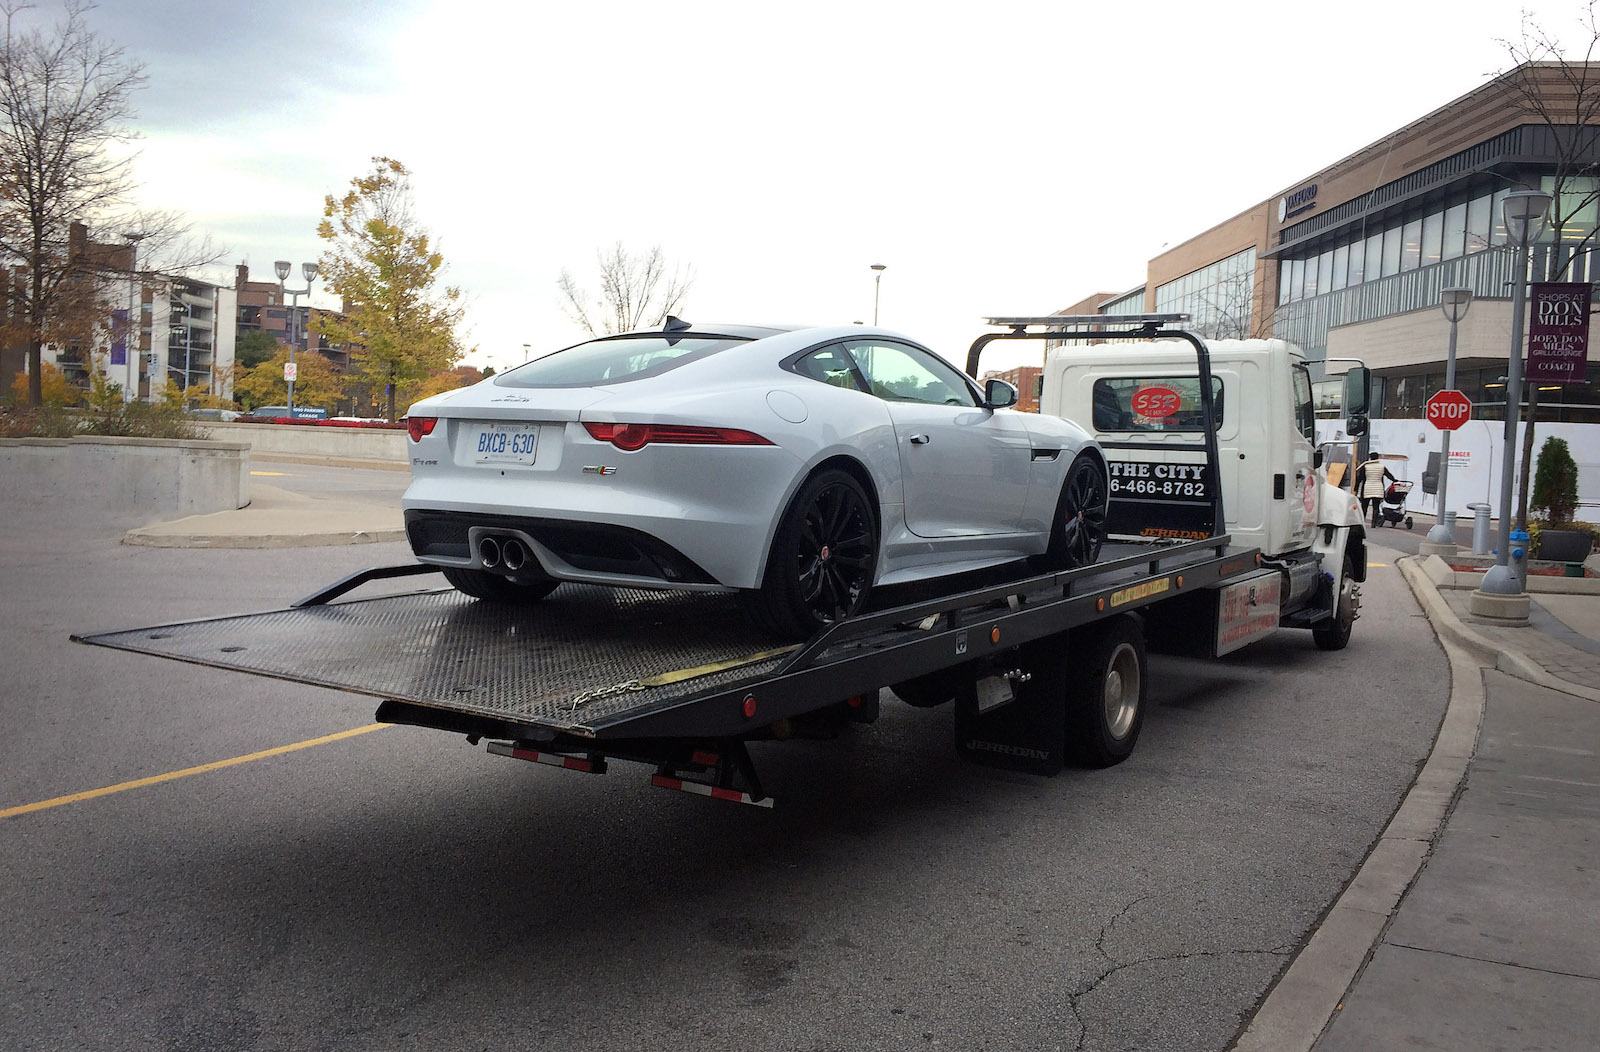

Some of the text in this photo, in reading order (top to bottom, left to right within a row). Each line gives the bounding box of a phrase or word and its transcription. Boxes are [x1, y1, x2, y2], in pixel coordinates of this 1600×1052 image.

[1538, 293, 1585, 302] SHOPS AT
[1539, 301, 1583, 315] DON
[1537, 315, 1582, 325] MILLS
[1562, 335, 1584, 343] DON
[1538, 362, 1575, 371] COACH
[1137, 395, 1177, 409] SSR
[1429, 402, 1468, 418] STOP
[1109, 463, 1205, 480] THE CITY
[1110, 479, 1205, 497] 6-466-8782
